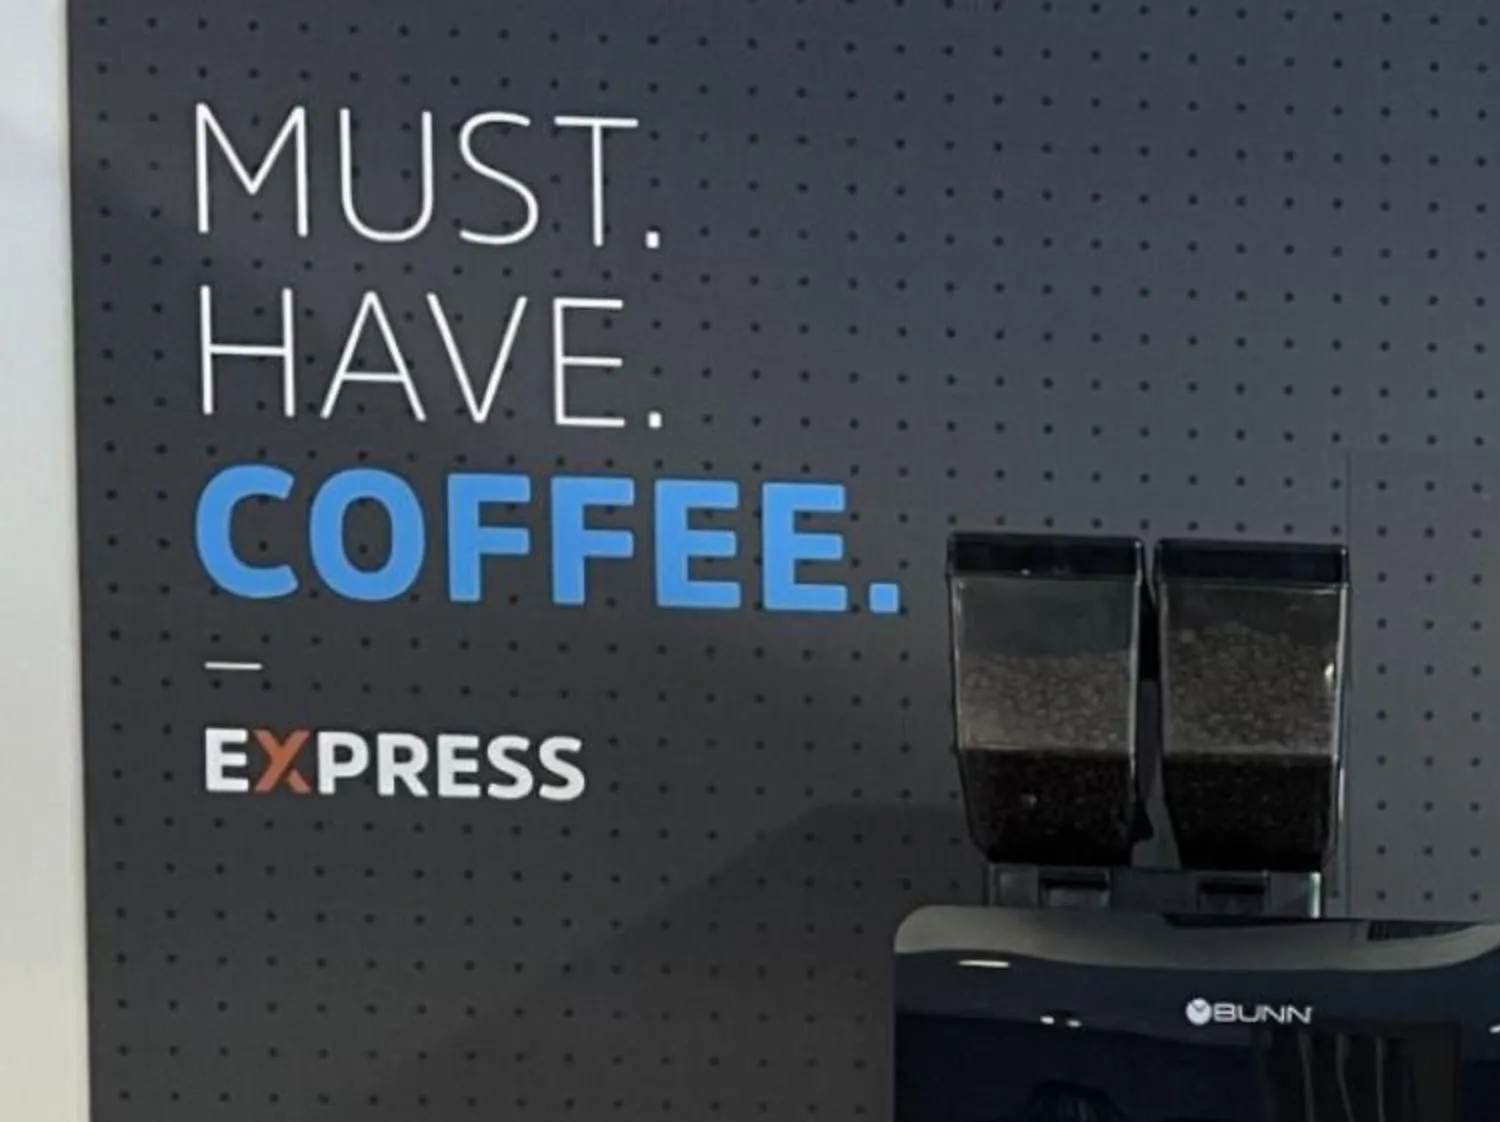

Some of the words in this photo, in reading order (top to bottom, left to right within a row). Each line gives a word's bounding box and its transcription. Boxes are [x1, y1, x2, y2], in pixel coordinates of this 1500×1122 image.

[196, 103, 659, 248] MUST.
[201, 286, 661, 428] HAVE.
[196, 465, 899, 613] COFFEE.
[205, 728, 585, 800] EXPRESS
[1213, 1003, 1312, 1023] BUNN
